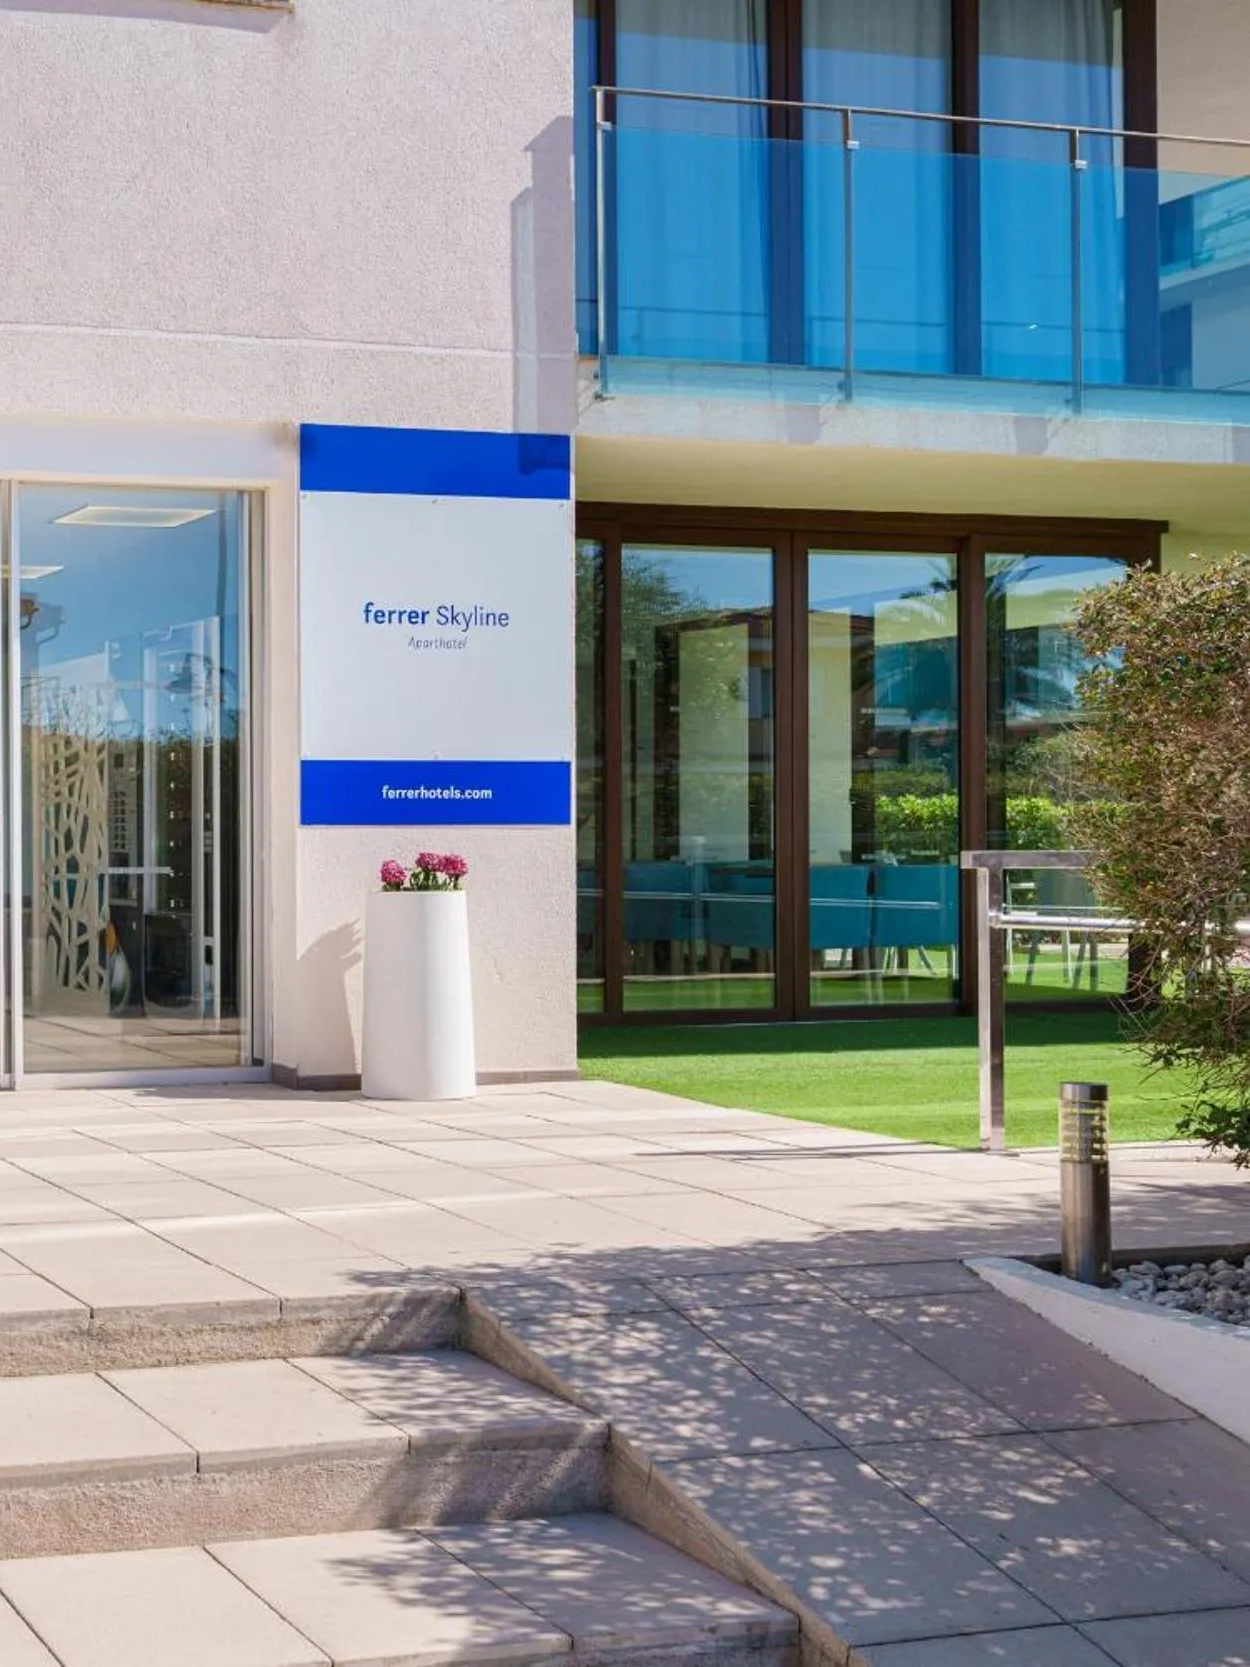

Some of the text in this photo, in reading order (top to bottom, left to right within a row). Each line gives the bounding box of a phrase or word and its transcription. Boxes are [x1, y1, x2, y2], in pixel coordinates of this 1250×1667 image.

[363, 601, 510, 632] ferrer Skyline
[407, 636, 468, 650] Aparthotel
[381, 784, 493, 800] ferrerhotels.com
